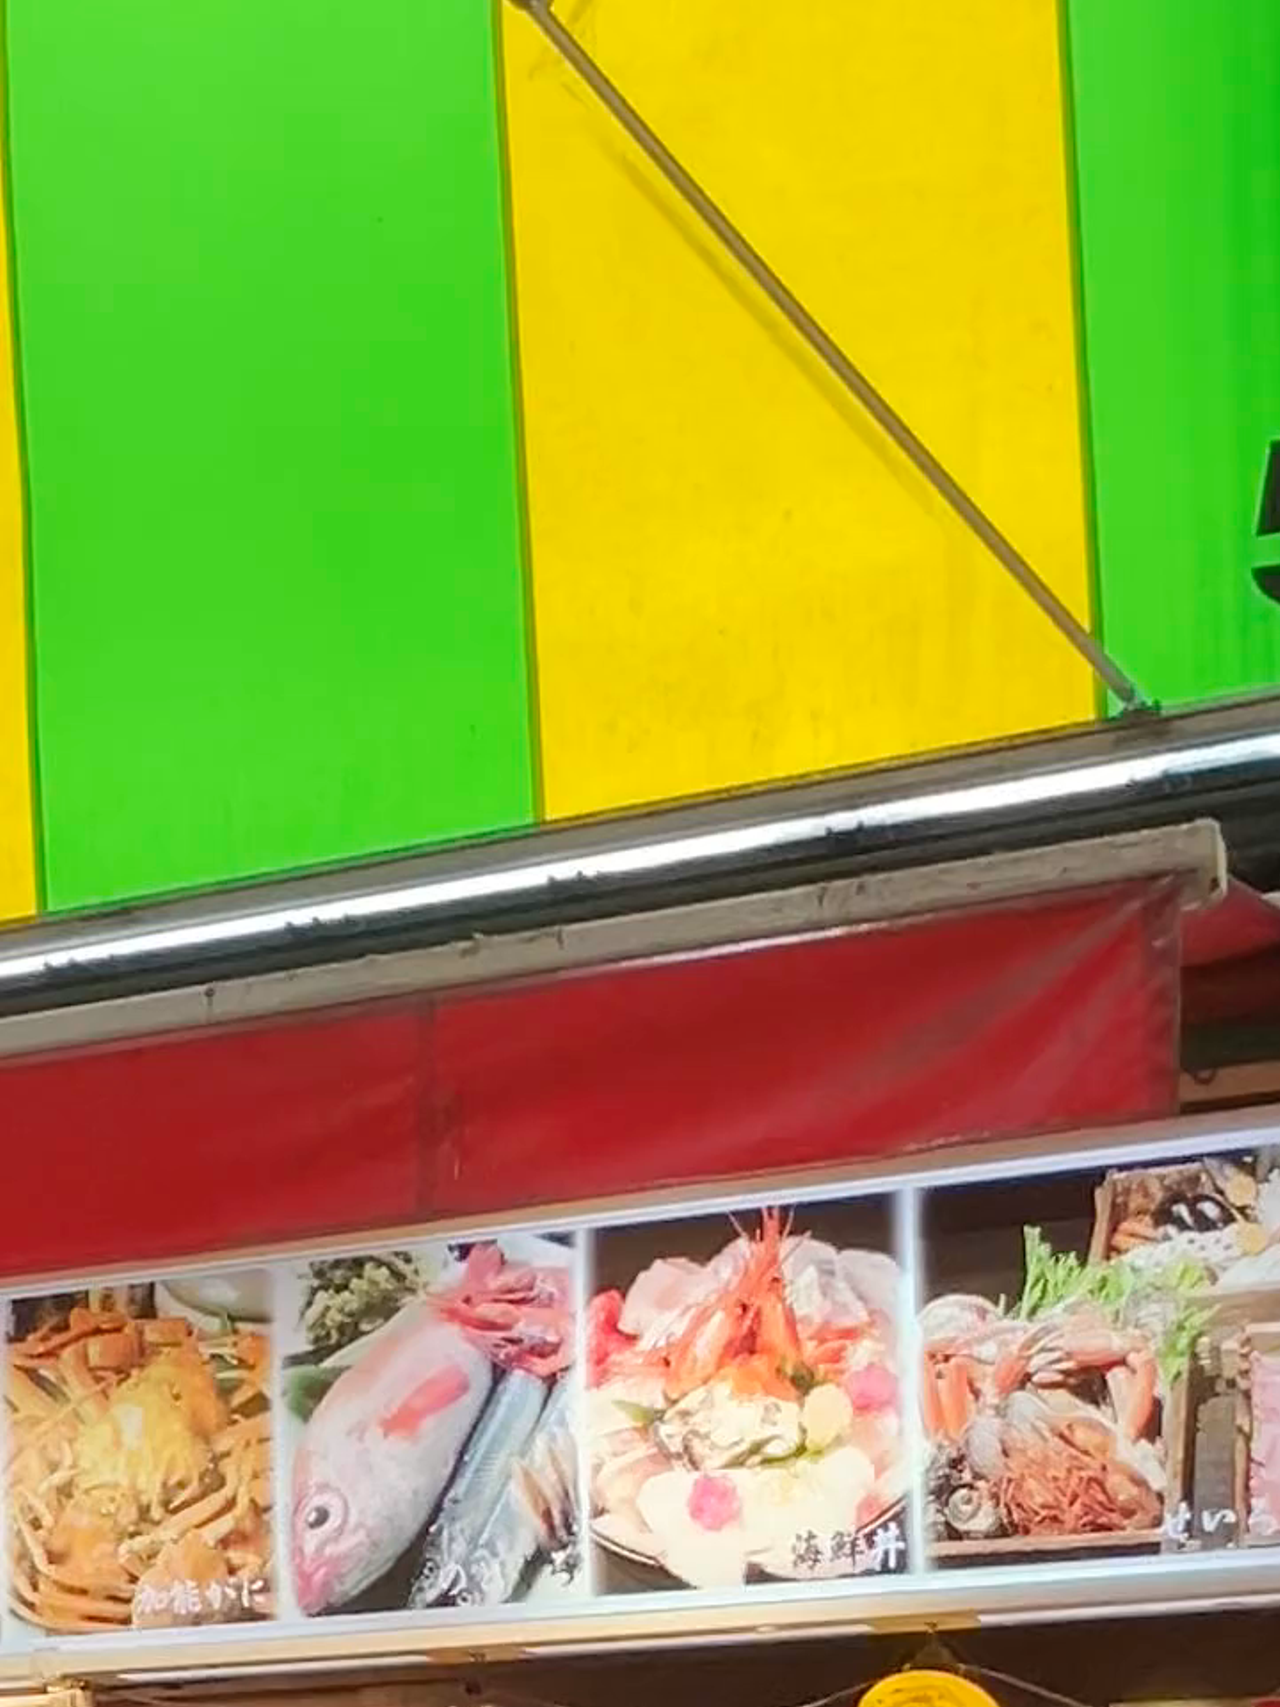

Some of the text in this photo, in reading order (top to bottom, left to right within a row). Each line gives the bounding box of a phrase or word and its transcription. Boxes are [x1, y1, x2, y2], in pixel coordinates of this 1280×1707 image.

[792, 1521, 906, 1571] 海鮮丼
[136, 1577, 267, 1615] 加能がに
